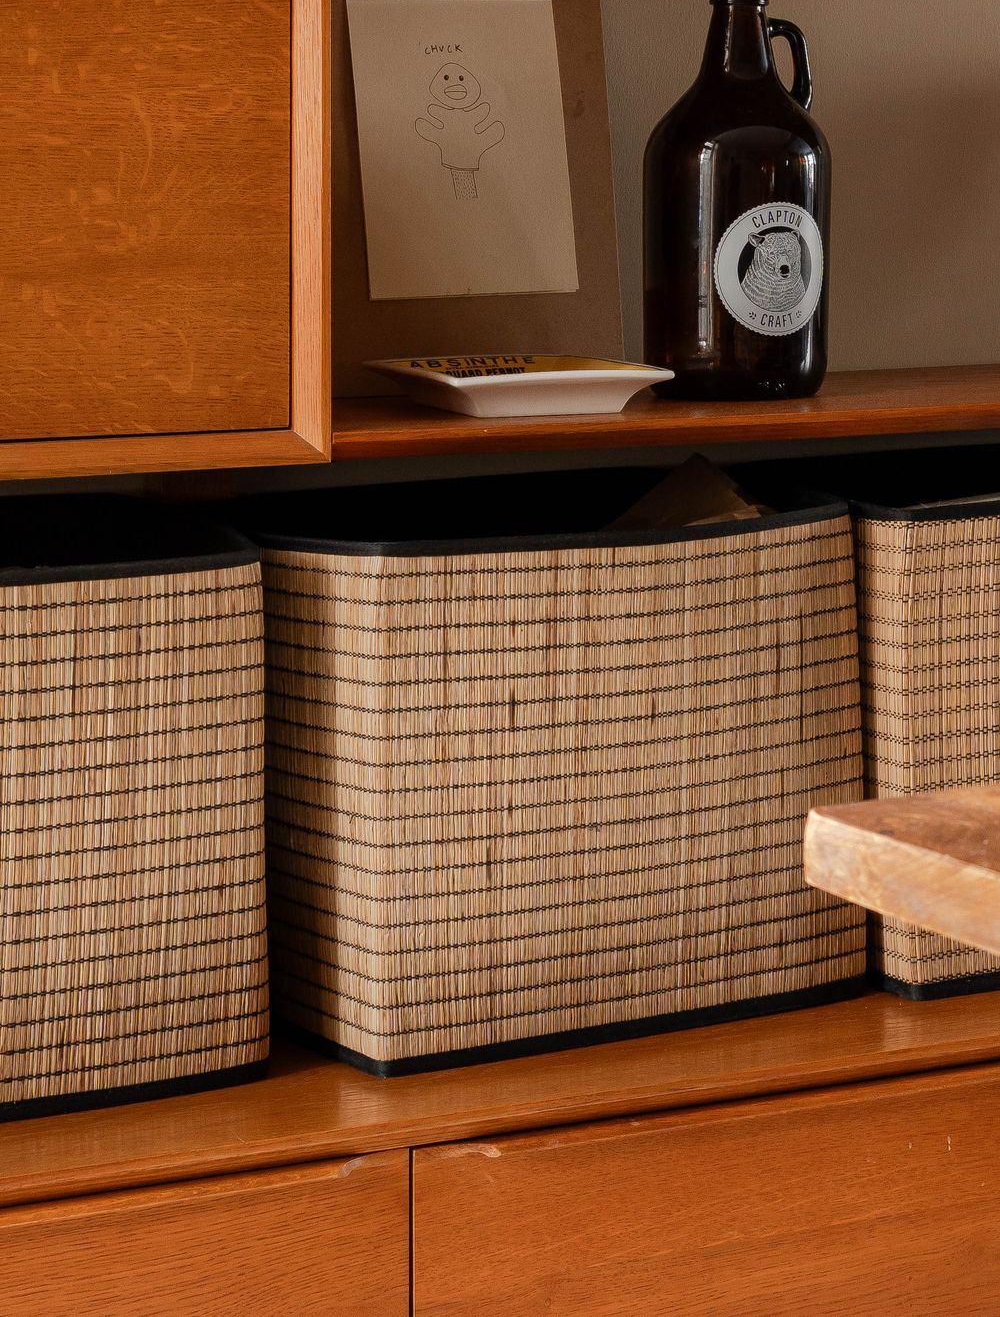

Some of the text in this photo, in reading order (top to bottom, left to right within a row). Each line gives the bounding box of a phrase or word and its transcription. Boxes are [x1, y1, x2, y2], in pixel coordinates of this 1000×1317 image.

[751, 210, 803, 229] CLAPTON
[760, 313, 793, 328] CRAFT
[410, 355, 536, 369] ABSINTHE
